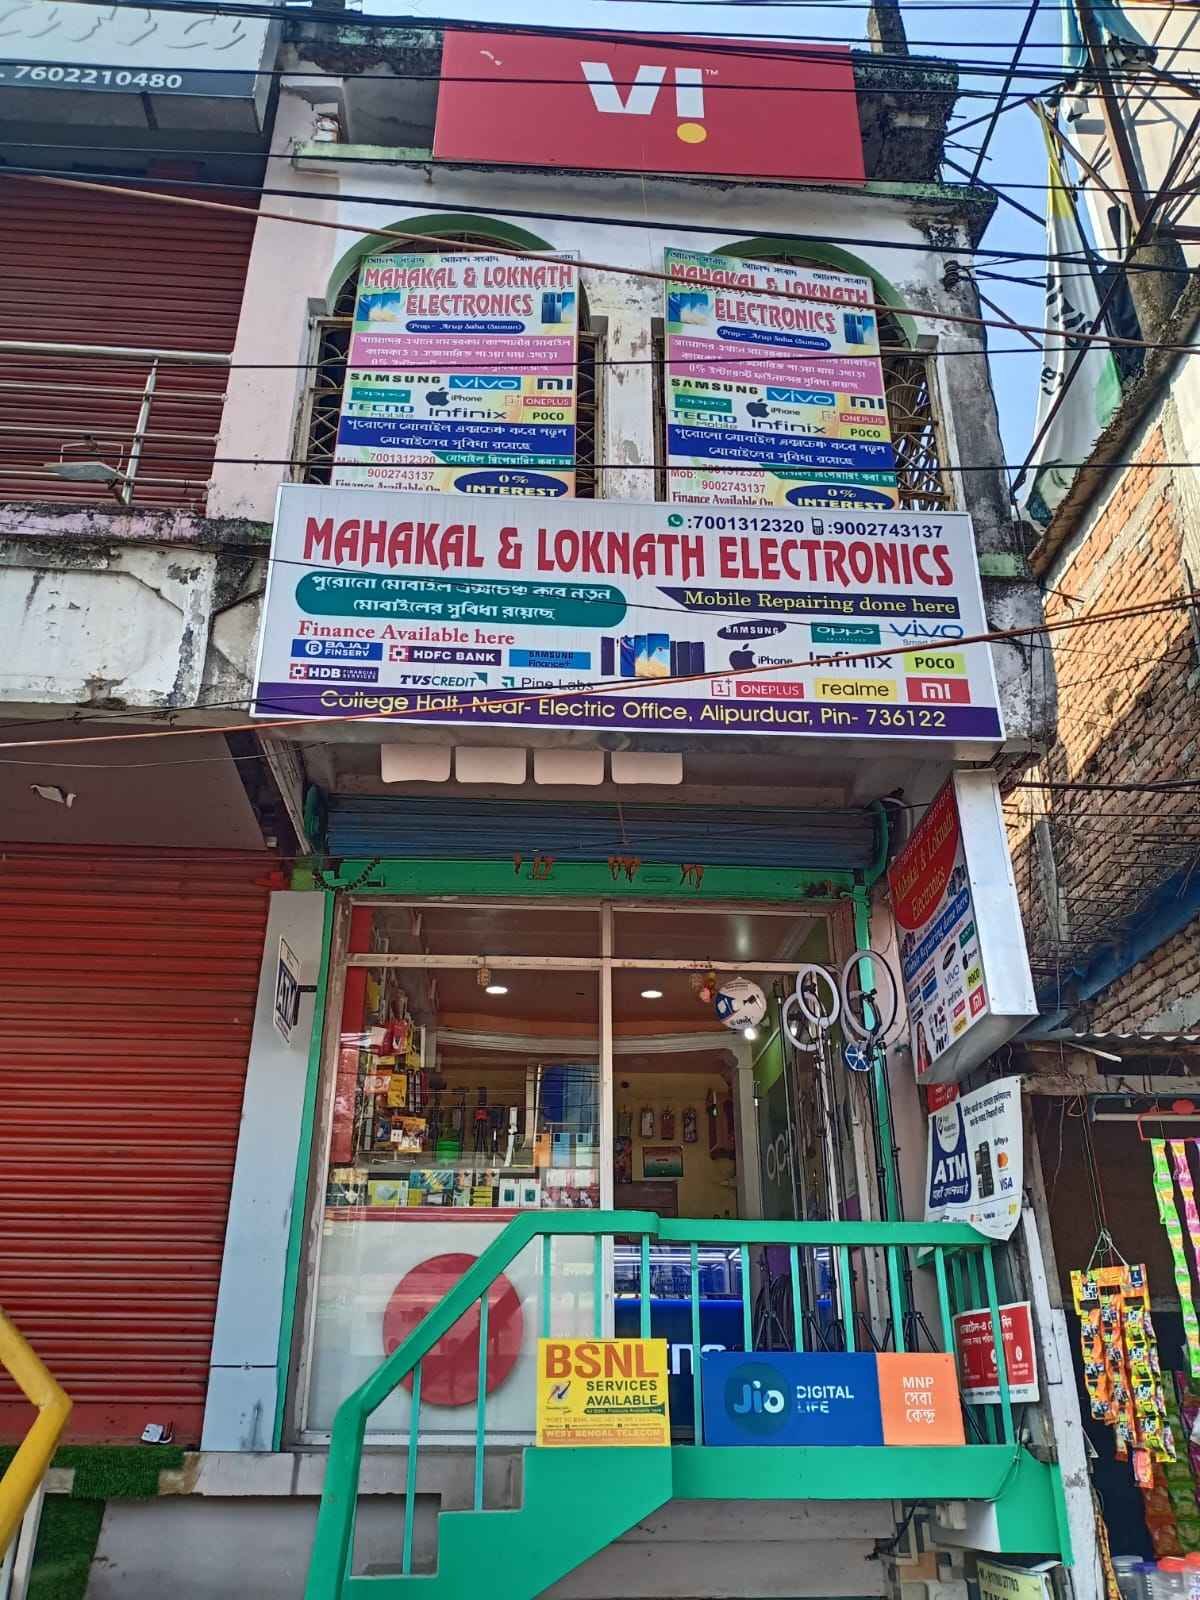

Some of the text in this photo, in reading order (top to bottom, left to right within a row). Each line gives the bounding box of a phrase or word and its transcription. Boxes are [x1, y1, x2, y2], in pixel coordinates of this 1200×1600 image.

[14, 66, 183, 88] 7602210480
[364, 266, 573, 289] MAHAKAL & LOKNATH
[406, 294, 533, 317] ELECTRONICS
[715, 298, 837, 333] ELECTRONICS
[350, 373, 441, 384] SAMSUNG
[455, 377, 518, 389] vivo
[672, 378, 759, 395] SAMSUNG
[526, 398, 570, 406] ONEPLUS
[771, 389, 833, 405] vivo
[349, 403, 414, 413] TECNO
[429, 408, 507, 419] Infinix
[771, 407, 801, 416] iPhone
[533, 412, 564, 421] POCO
[672, 410, 737, 423] TECNO
[842, 414, 884, 425] ONEPLUS
[752, 418, 826, 433] Infinix
[851, 428, 881, 437] POCO
[369, 453, 437, 465] 7001312320
[368, 468, 435, 481] 9002743137
[465, 484, 558, 497] INTEREST
[702, 480, 766, 493] 9002743137
[673, 491, 710, 504] Finance
[712, 493, 755, 507] Available
[798, 498, 886, 510] INTEREST
[303, 517, 953, 587] MAHAKAL & LOKNATH ELECTRONICS
[312, 575, 378, 592] পুরোনো
[381, 578, 452, 593] মোবাইল
[571, 588, 611, 604] নতুন
[354, 598, 556, 621] মোবাইলের সুবিধা রয়েছে
[684, 590, 956, 616] Mobile Repairing done here
[298, 620, 515, 645] Finance Available here
[726, 625, 780, 635] SAMSUNG
[889, 619, 965, 639] vivo
[325, 641, 370, 650] BAJAJ
[324, 648, 370, 657] FINSERV
[414, 650, 497, 662] HDFC BANK
[528, 650, 574, 660] SAMSUNG
[758, 655, 793, 666] iPhone
[915, 657, 955, 669] POCO
[308, 667, 341, 679] HDB
[521, 677, 594, 691] Pine Labs
[740, 684, 800, 696] ONEPLUS
[821, 682, 889, 697] realme
[320, 690, 409, 712] College
[538, 699, 615, 718] Electric
[622, 702, 694, 724] Office,
[699, 703, 814, 726] Alipurduar,
[821, 707, 859, 725] Pin-
[866, 709, 947, 728] 736122
[933, 1152, 968, 1186] ATM
[1000, 1176, 1013, 1191] VISA
[546, 1344, 659, 1378] BSNL
[586, 1380, 657, 1391] SERVICES
[902, 1376, 934, 1389] MNP
[734, 1380, 785, 1414] Jio
[796, 1386, 854, 1399] DIGITAL
[905, 1391, 933, 1407] সেবা
[587, 1395, 657, 1406] AVAILABLE
